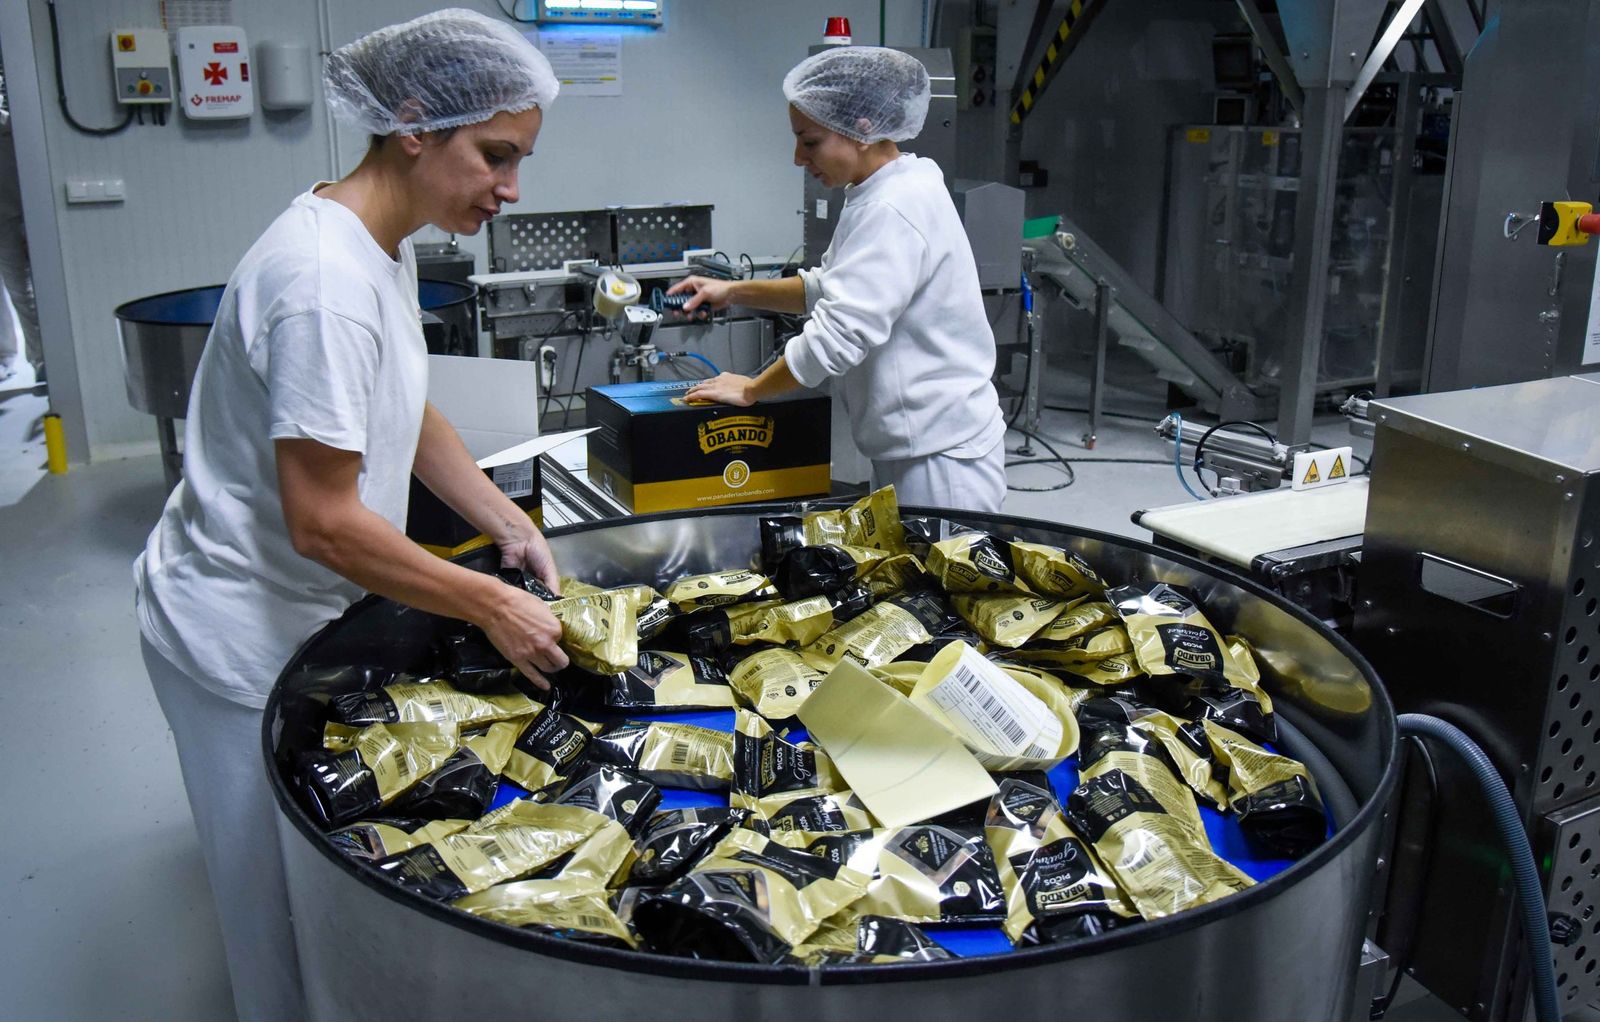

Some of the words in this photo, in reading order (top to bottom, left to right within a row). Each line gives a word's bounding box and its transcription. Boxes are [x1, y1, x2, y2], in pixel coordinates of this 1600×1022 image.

[205, 95, 241, 103] FREMAP
[706, 428, 767, 448] OBANDO
[1177, 650, 1211, 662] OBANDO
[550, 729, 567, 745] PICOS
[1043, 872, 1071, 886] PICOS
[1040, 884, 1085, 903] OBANDO
